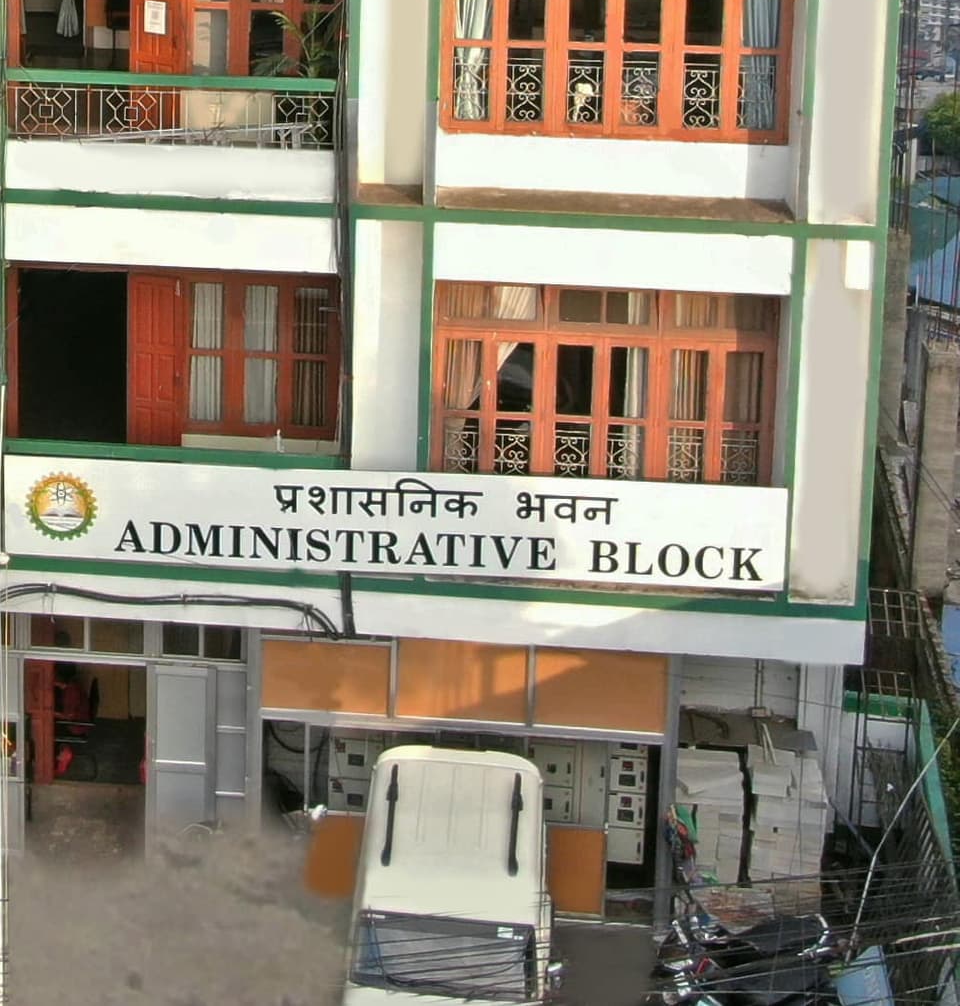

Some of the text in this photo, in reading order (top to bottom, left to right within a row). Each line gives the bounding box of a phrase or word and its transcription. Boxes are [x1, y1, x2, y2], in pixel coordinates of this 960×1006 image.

[273, 478, 619, 525] प्रशासनिक भवन
[114, 519, 763, 582] ADMINISTRATIVE BLOCK
